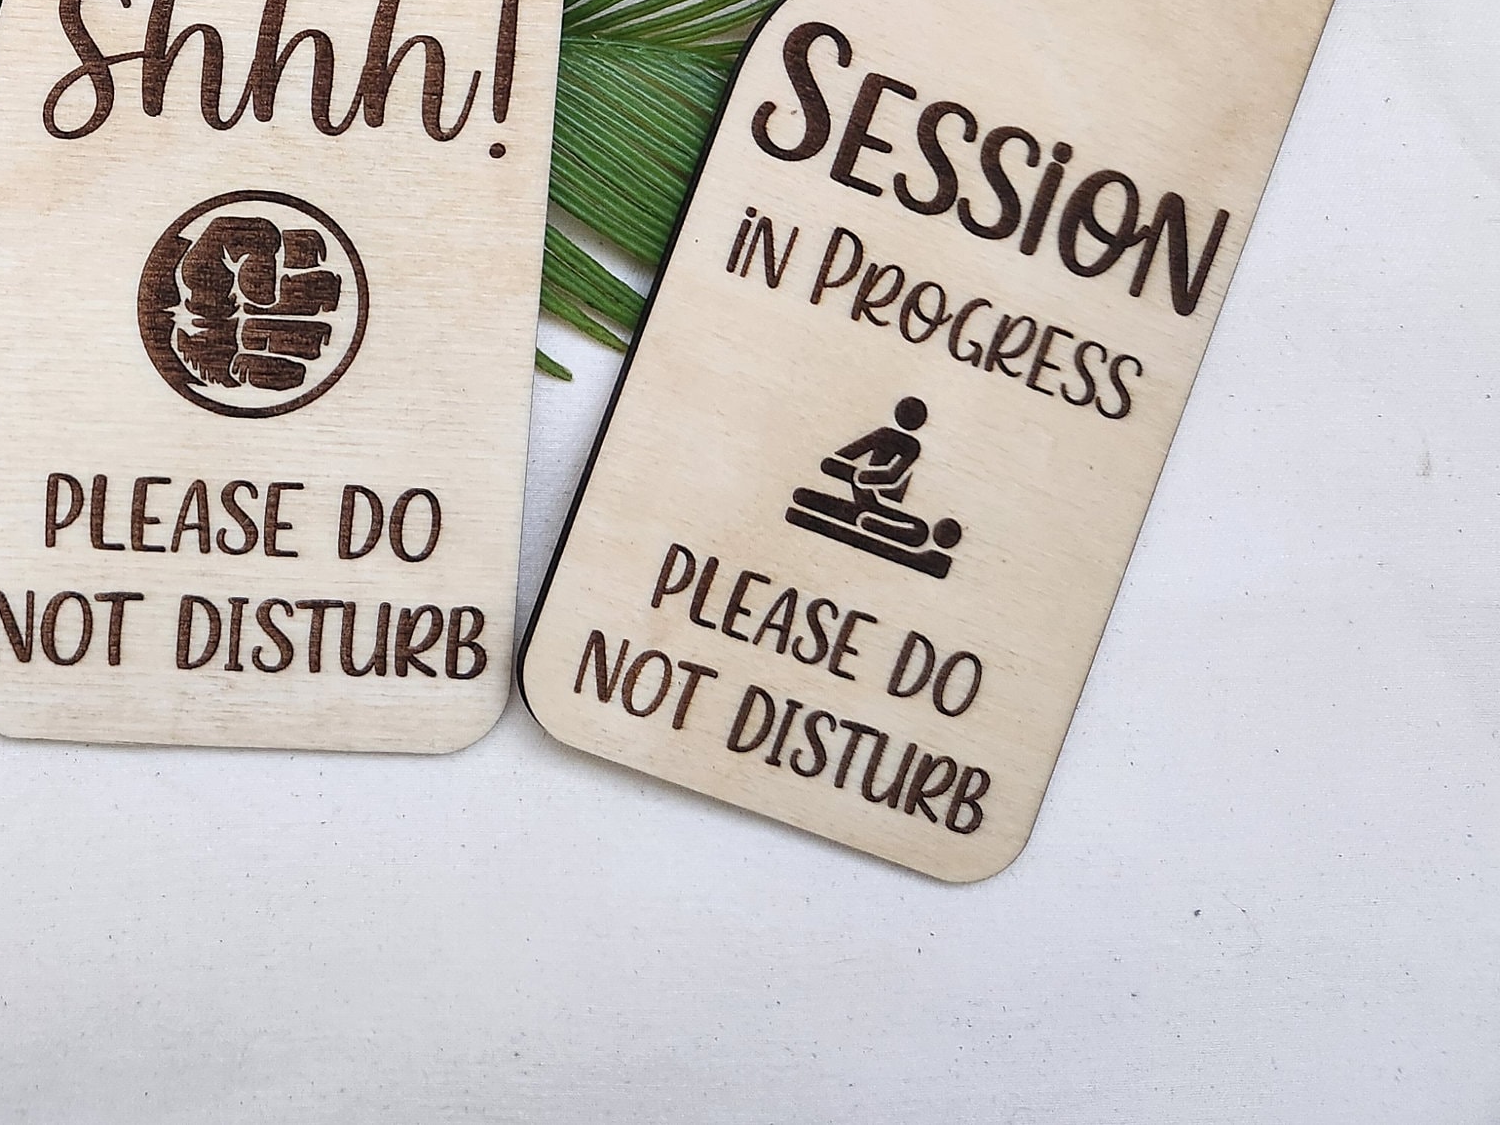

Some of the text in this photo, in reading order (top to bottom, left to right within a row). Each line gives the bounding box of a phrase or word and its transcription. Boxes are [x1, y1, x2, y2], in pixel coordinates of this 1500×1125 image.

[809, 226, 1144, 420] PROGRESS
[44, 472, 442, 563] PLEASE DO
[175, 594, 488, 681] DISTURB
[650, 542, 983, 718] PLEASE DO
[573, 629, 992, 835] NOT DISTURB
